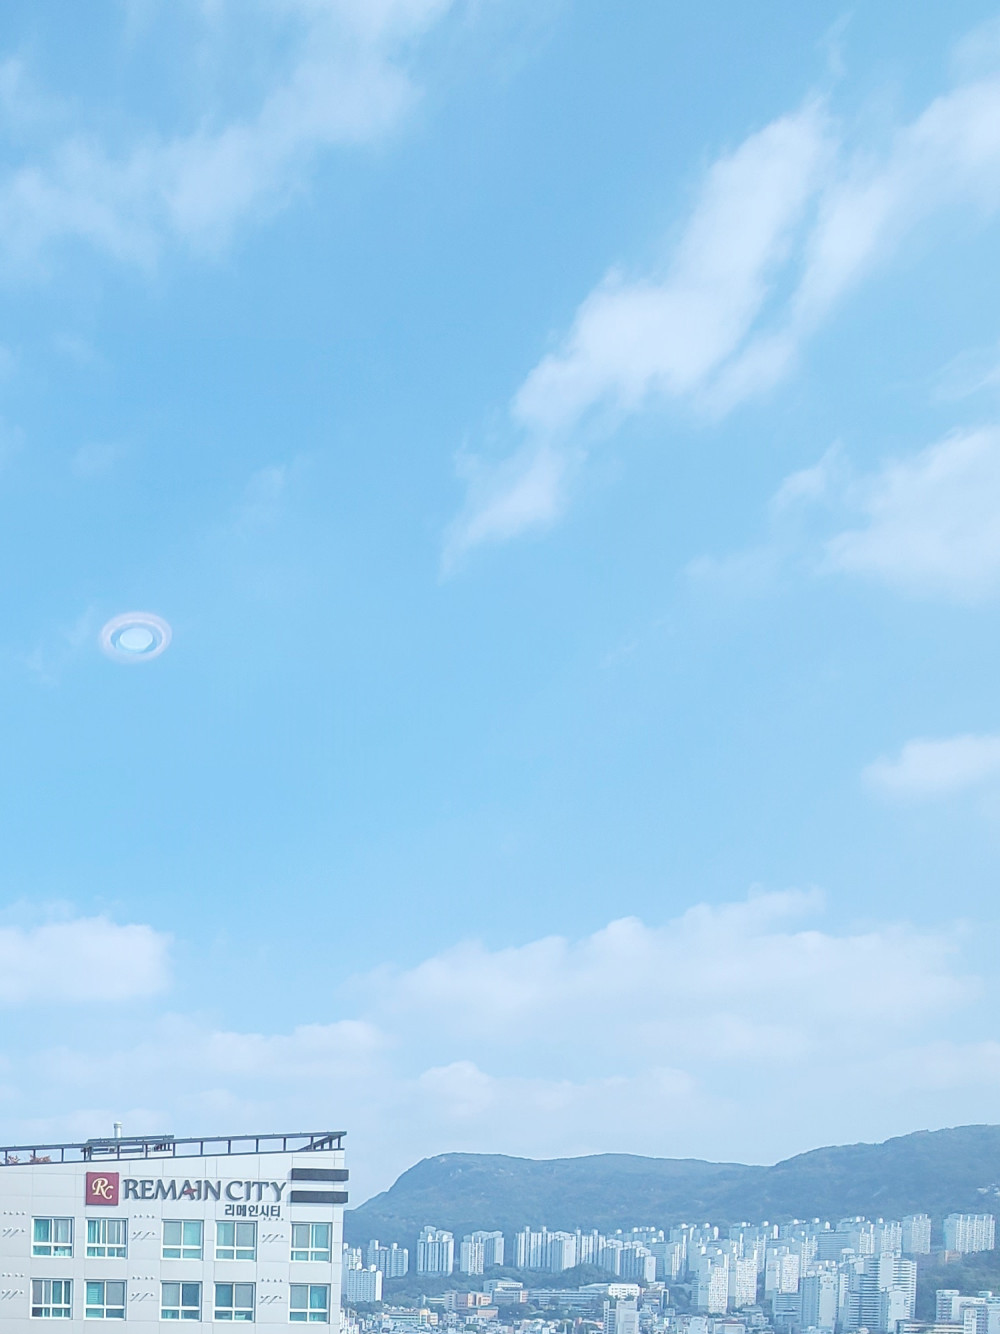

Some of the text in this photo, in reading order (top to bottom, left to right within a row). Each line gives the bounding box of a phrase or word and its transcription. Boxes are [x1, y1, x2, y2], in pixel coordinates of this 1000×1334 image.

[123, 1178, 286, 1202] REMAIN CITY
[225, 1204, 281, 1218] 리메인시티
